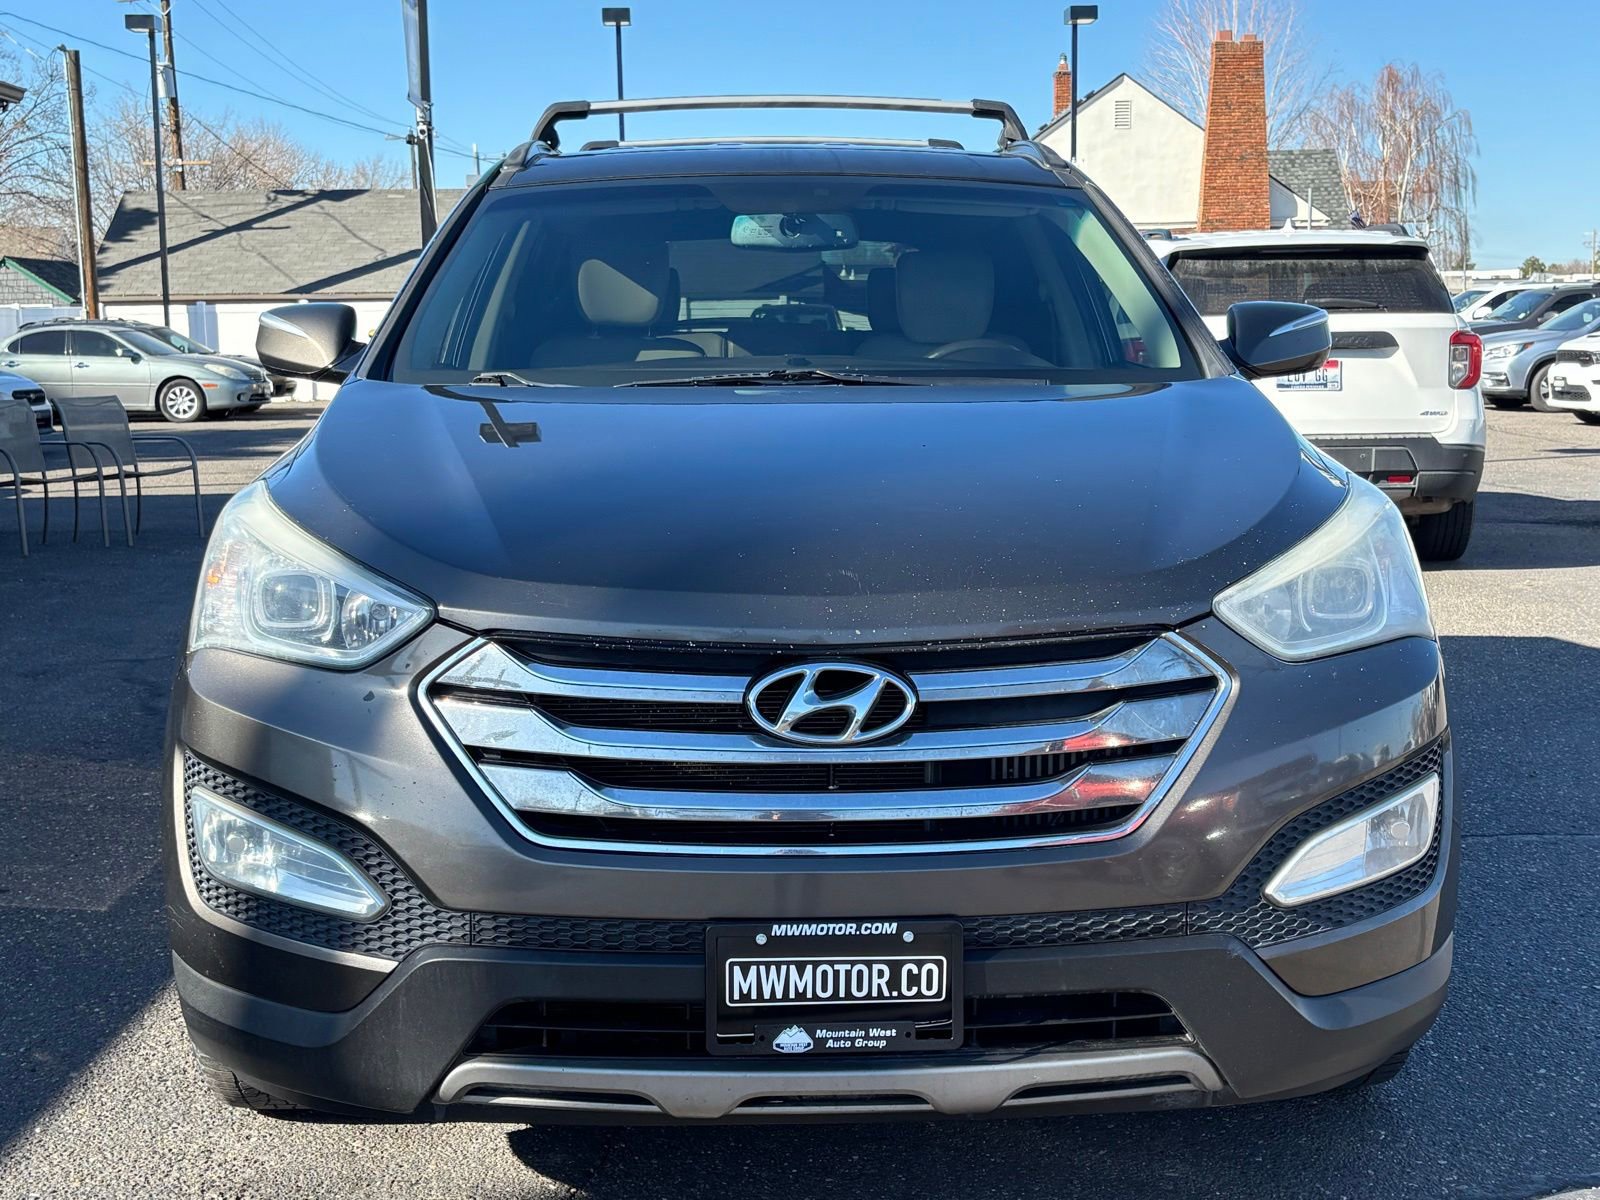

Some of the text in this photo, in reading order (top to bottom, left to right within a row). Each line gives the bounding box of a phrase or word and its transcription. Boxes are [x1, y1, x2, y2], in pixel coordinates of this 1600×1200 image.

[772, 923, 897, 936] MWMOTOR.COM
[733, 963, 939, 1000] MWMOTOR.CO
[815, 1027, 897, 1038] Mountain West
[825, 1038, 888, 1049] Auto Group
